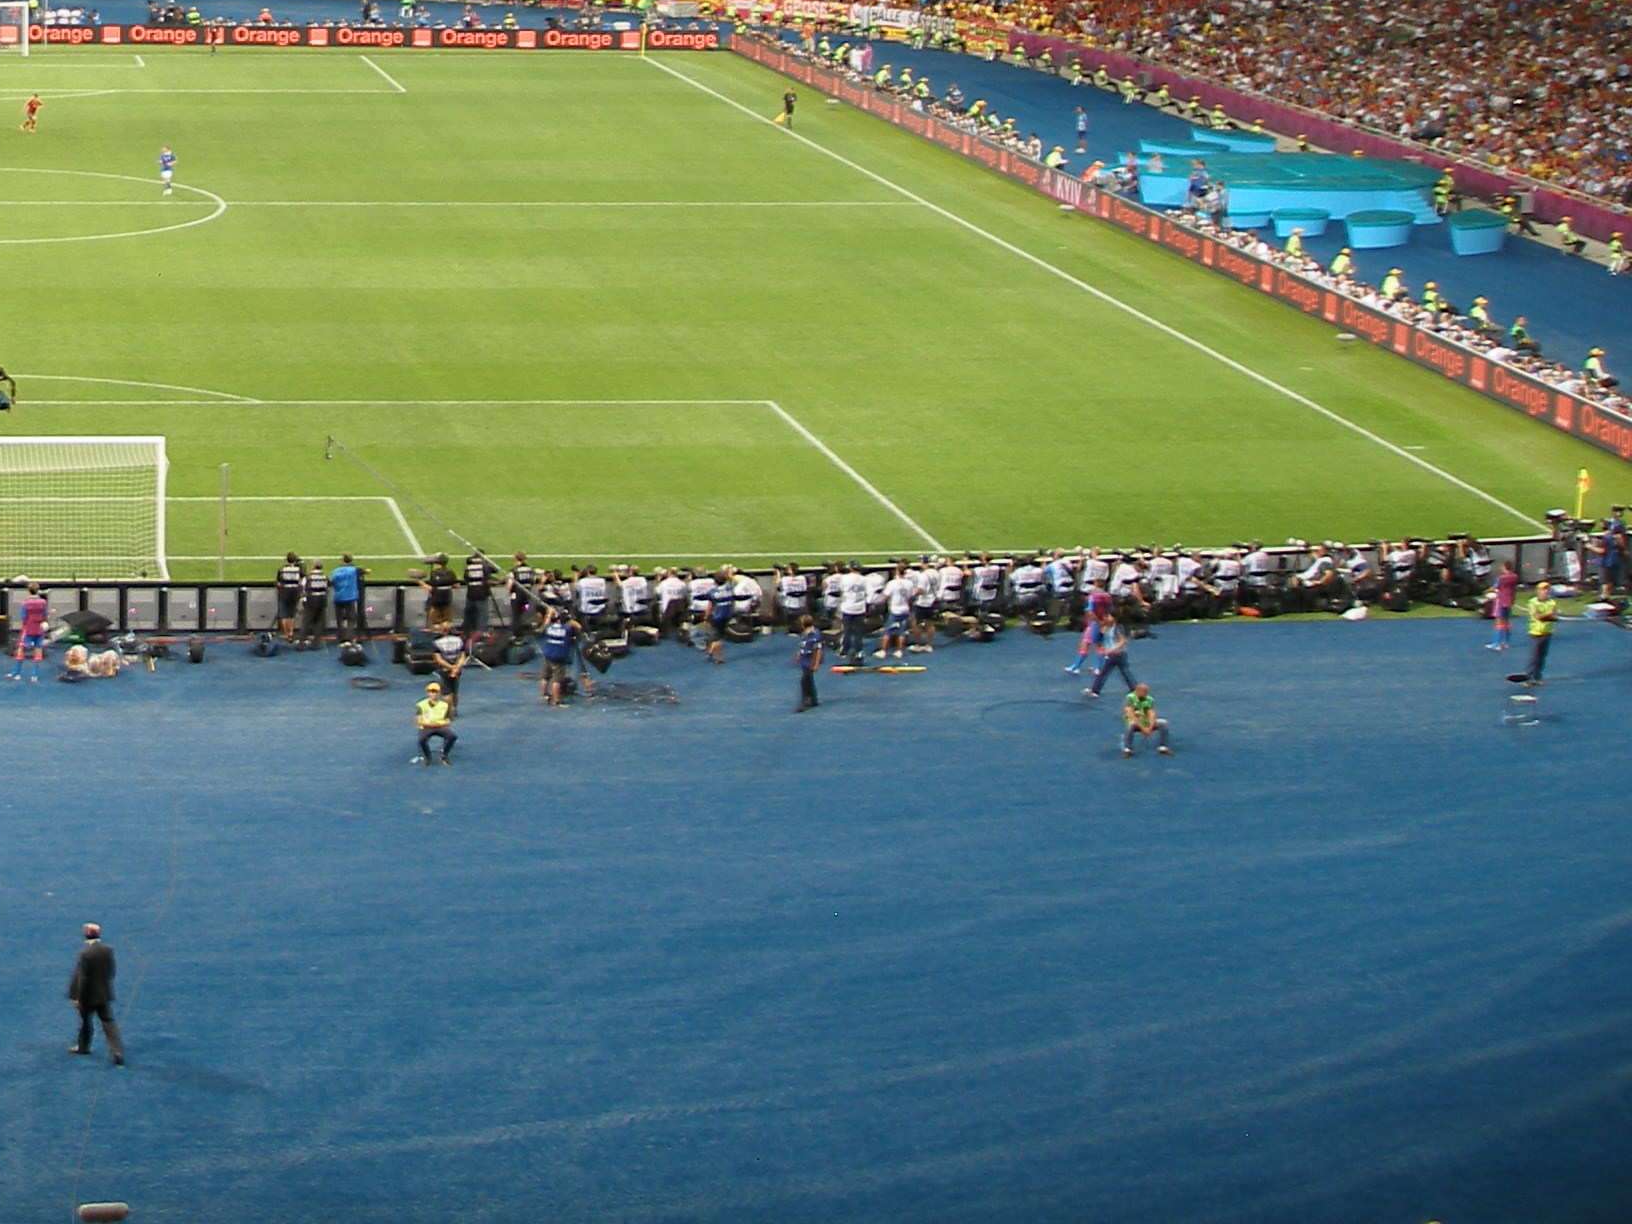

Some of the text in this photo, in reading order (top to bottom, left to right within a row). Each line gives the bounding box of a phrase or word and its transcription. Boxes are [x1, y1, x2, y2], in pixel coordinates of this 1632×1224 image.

[28, 25, 93, 44] Orange
[130, 26, 197, 45] Orange
[233, 26, 300, 46] Orange
[337, 27, 404, 47] Orange
[442, 28, 509, 48] Orange
[546, 29, 612, 50] Orange
[650, 30, 717, 51] Orange
[1056, 174, 1082, 206] KYIV
[1278, 271, 1319, 313] Orange
[1342, 299, 1388, 345] Orange
[1415, 331, 1465, 379] Orange
[1492, 366, 1549, 417] Orange
[1579, 403, 1632, 459] Orang
